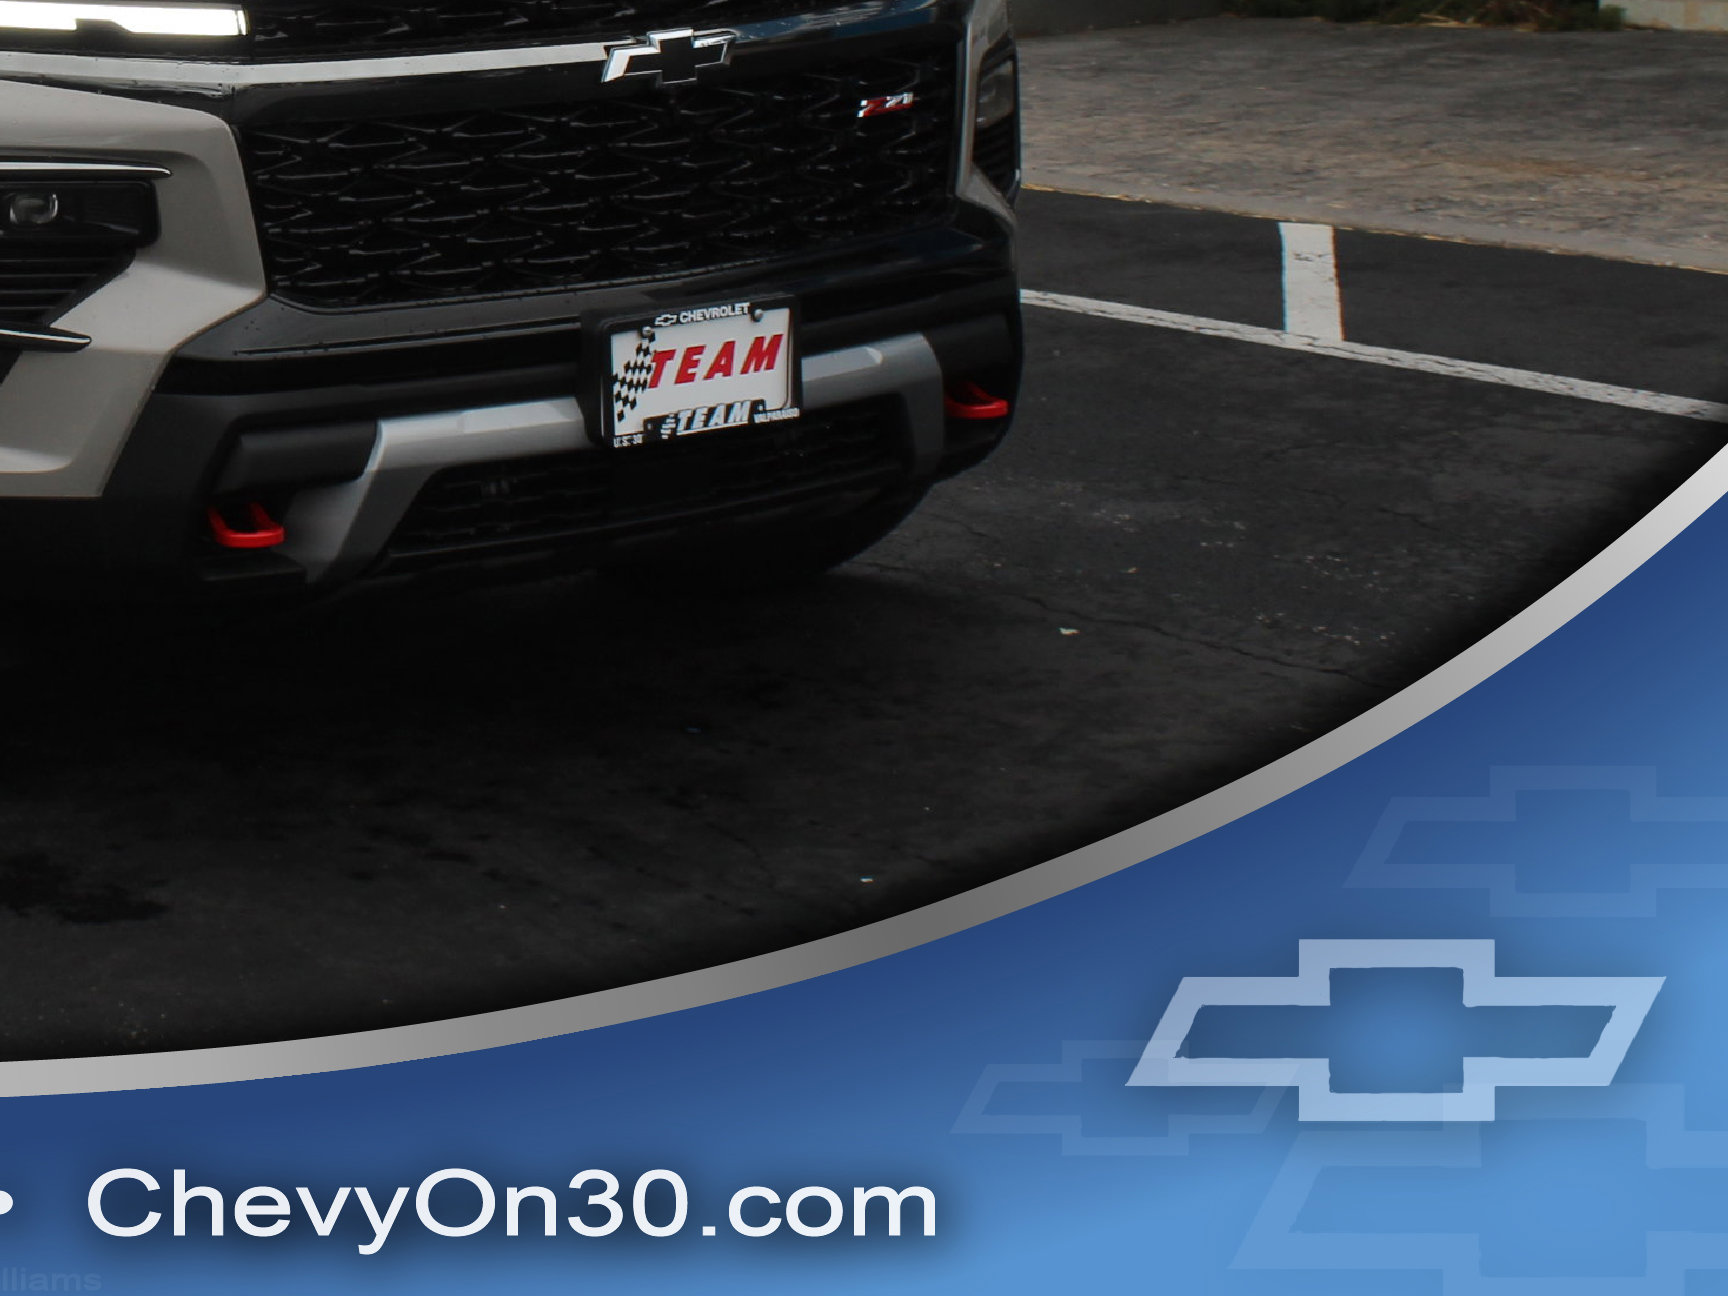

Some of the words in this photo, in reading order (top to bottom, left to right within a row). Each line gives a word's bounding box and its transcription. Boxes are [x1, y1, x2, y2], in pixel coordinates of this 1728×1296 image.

[679, 302, 750, 323] CHEVROLET
[648, 333, 784, 389] TEAM
[675, 399, 752, 434] TEAM
